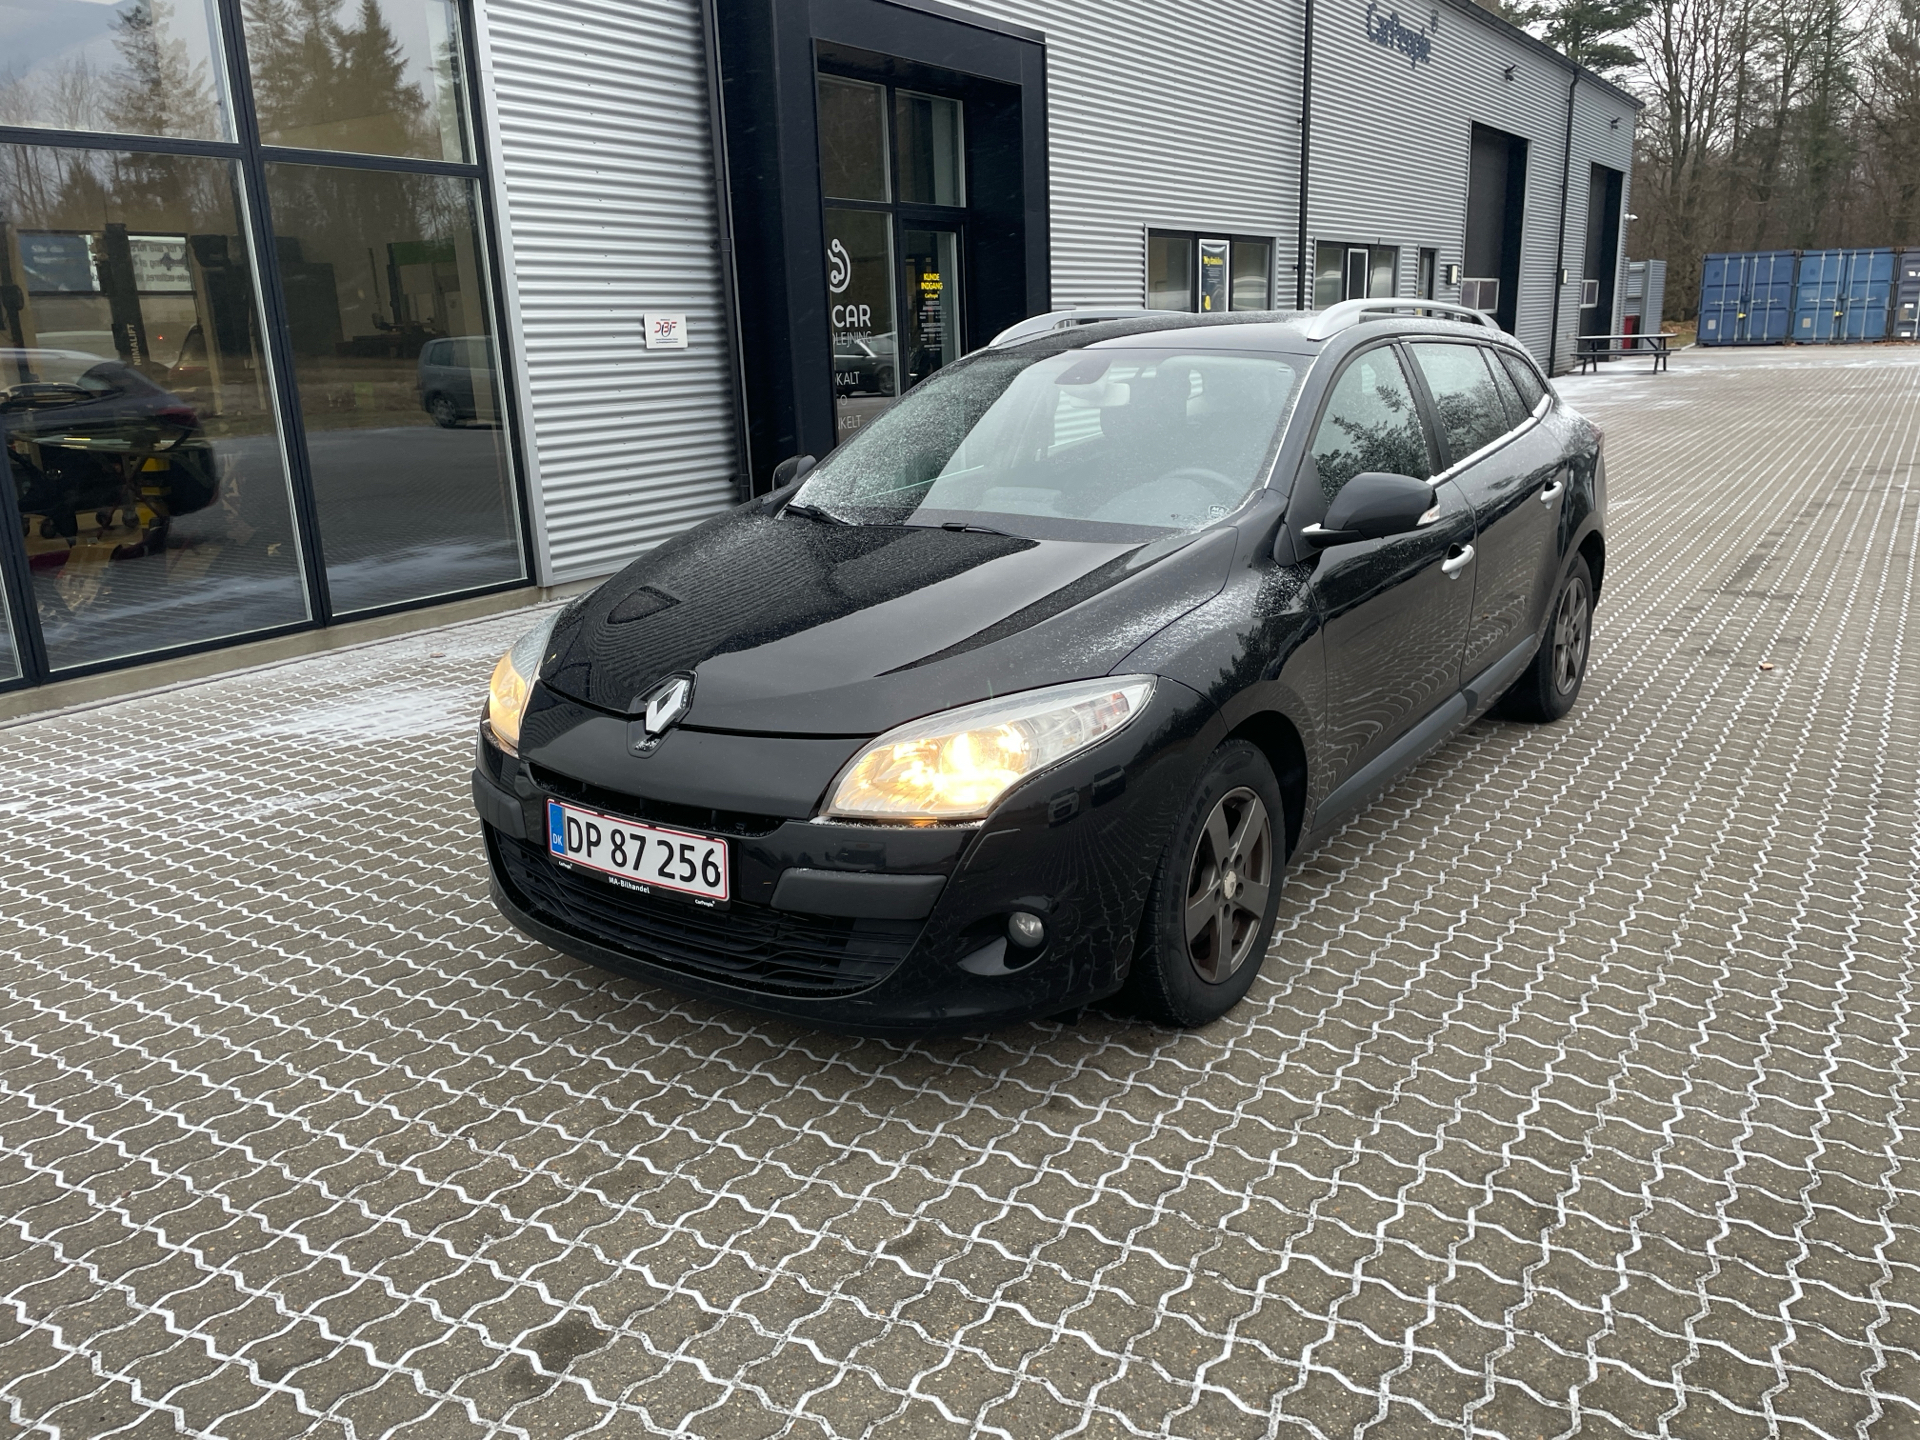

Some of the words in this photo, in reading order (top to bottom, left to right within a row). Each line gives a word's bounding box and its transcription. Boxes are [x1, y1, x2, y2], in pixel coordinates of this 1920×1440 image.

[832, 305, 871, 328] CAR
[127, 323, 142, 366] NIMALIFT
[833, 331, 872, 348] LEJNING
[835, 371, 860, 387] KALT
[552, 834, 563, 847] DK
[566, 816, 602, 858] DP
[610, 829, 646, 871] 87
[657, 840, 721, 888] 256
[608, 876, 650, 894] MA-Bilhandel
